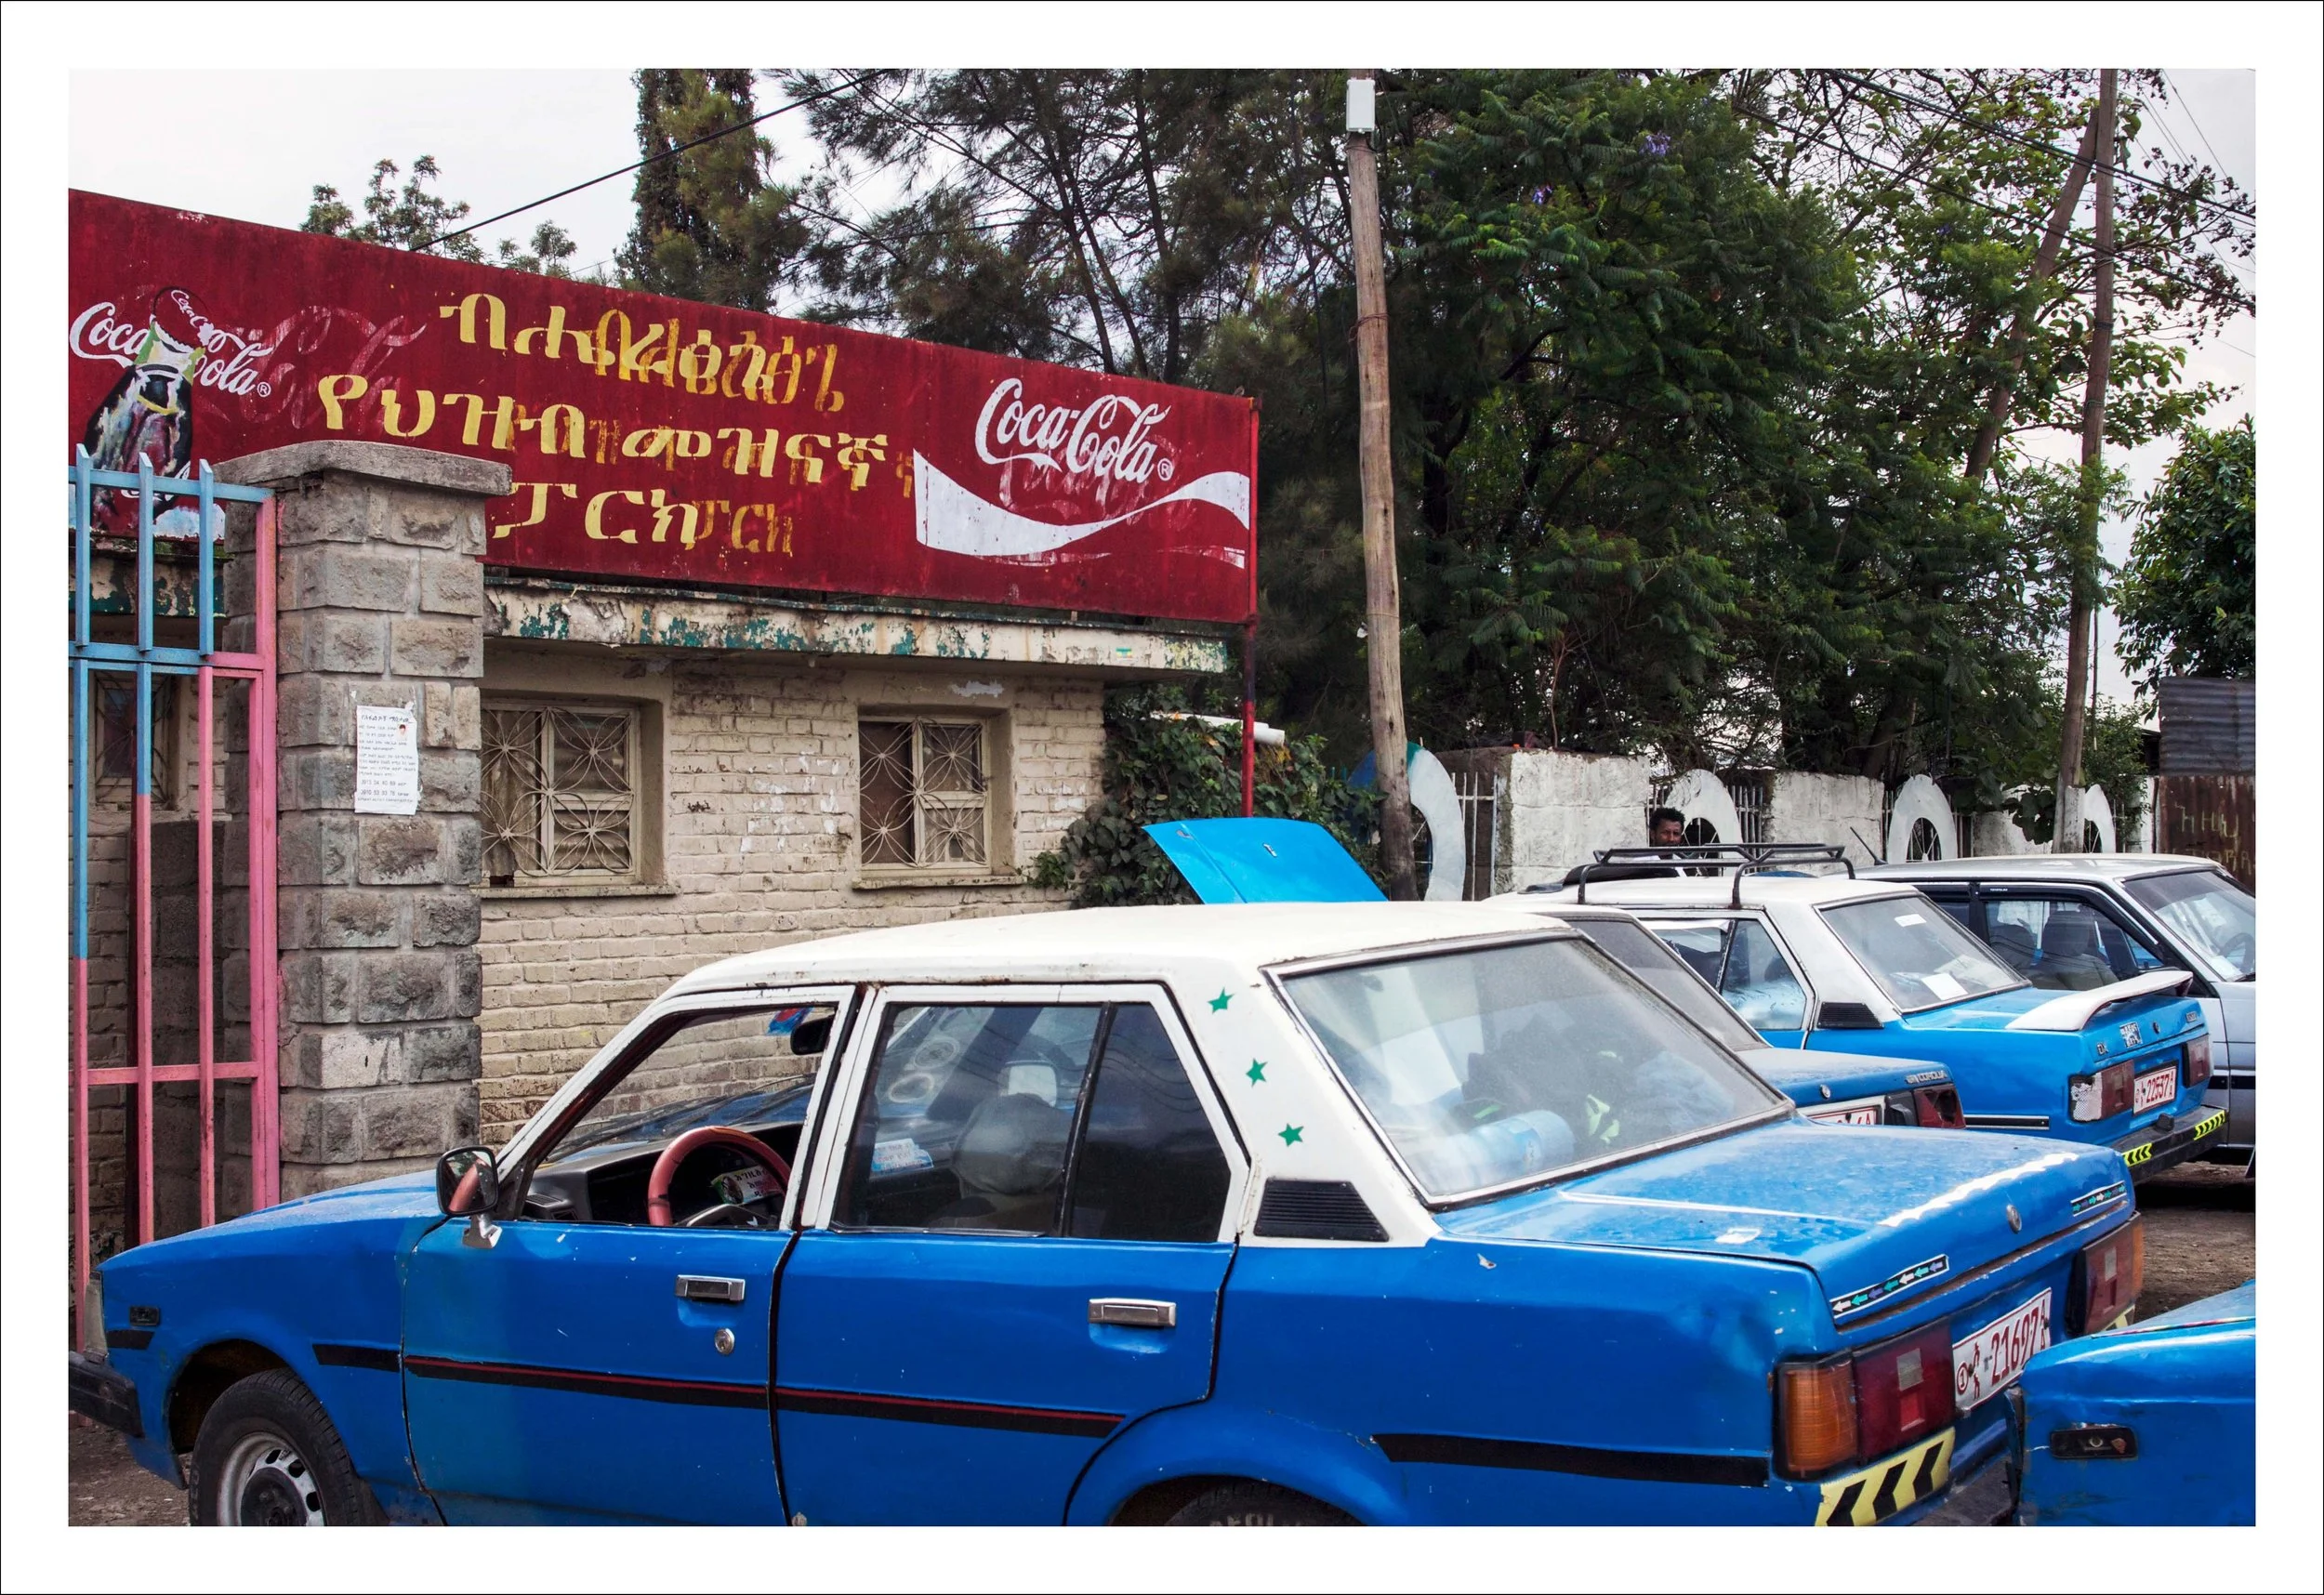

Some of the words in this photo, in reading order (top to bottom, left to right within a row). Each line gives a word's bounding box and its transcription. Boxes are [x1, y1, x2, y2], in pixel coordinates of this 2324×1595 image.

[974, 377, 1171, 483] Coca-Cola
[492, 481, 699, 545] ፓርክ
[1991, 1306, 2040, 1387] 21697
